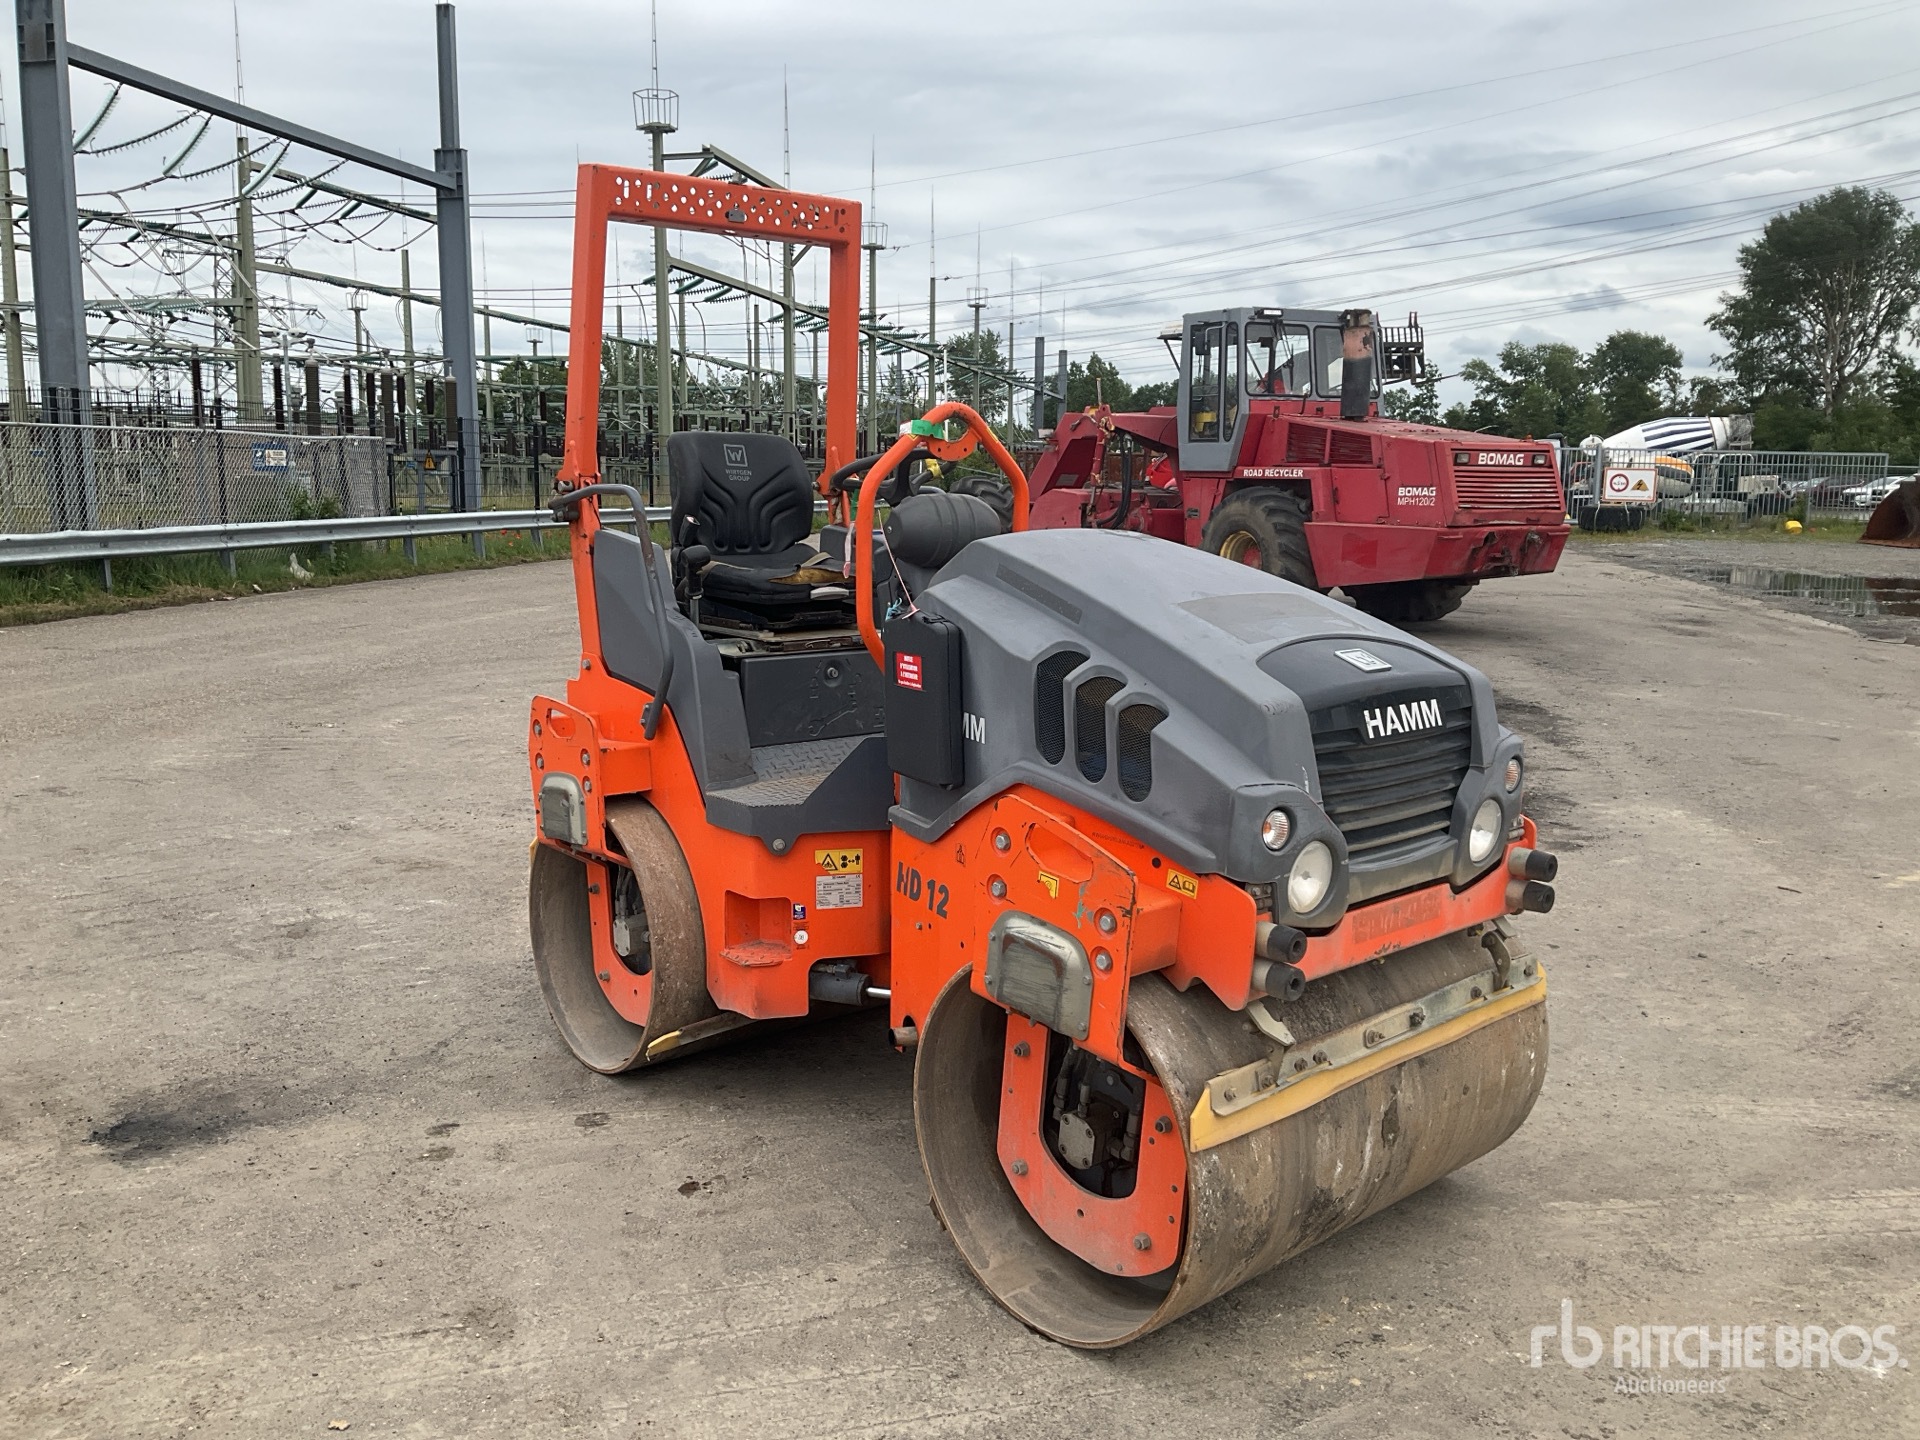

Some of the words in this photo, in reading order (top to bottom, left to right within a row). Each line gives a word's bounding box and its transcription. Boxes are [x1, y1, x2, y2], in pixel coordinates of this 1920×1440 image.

[1478, 452, 1525, 466] BOMAG
[725, 468, 752, 476] WIRTGEN
[1243, 468, 1263, 477] ROAD
[1264, 468, 1304, 478] RECYCLER
[728, 474, 751, 482] GROUP
[1398, 487, 1437, 496] BOMAG
[1397, 496, 1436, 506] MPH120/2
[1363, 698, 1442, 739] HAMM
[896, 861, 922, 902] HD
[927, 879, 949, 919] 12
